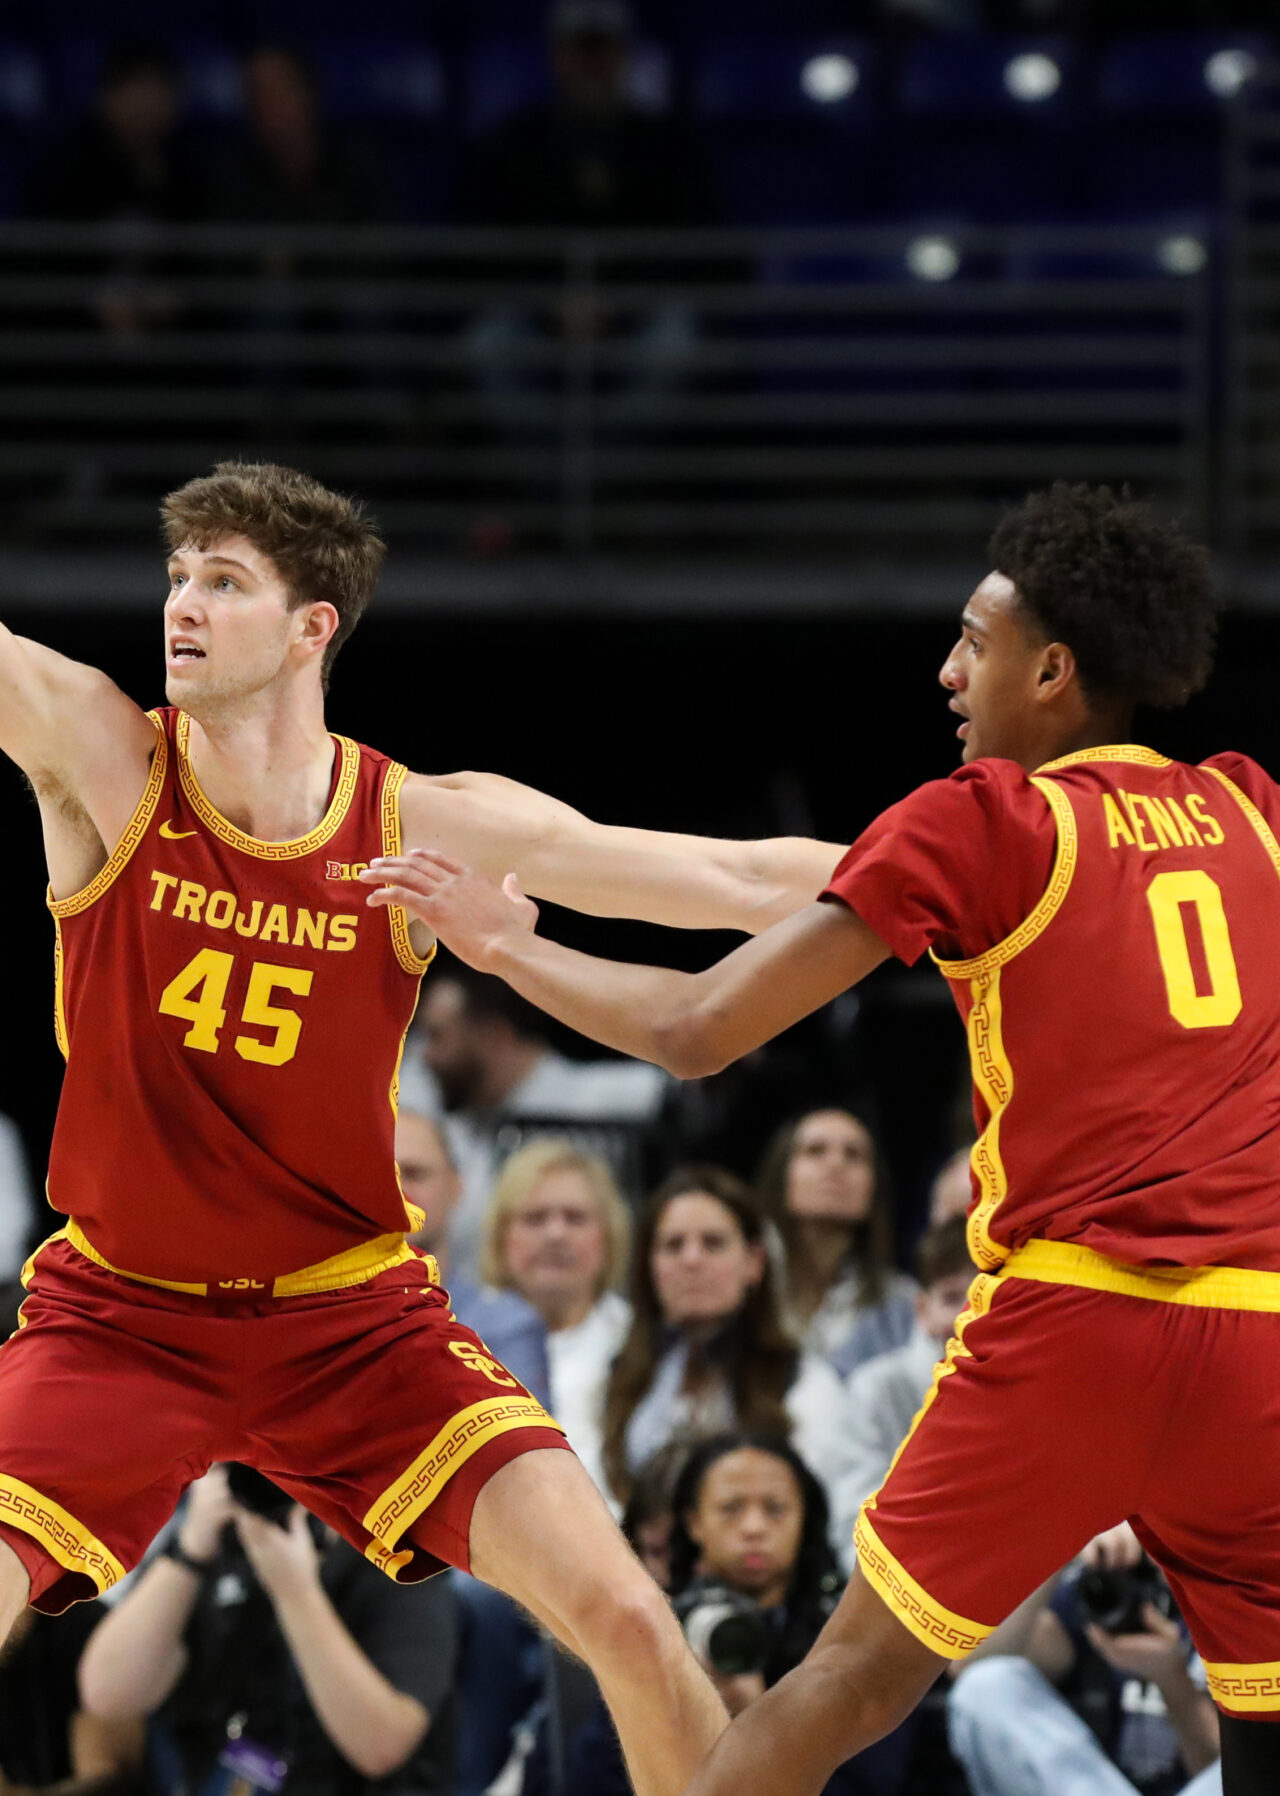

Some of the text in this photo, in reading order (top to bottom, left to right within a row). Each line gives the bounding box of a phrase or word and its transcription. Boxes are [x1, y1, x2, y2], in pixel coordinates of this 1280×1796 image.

[1101, 787, 1226, 852] AENAS
[149, 869, 359, 952] TROJANS
[1145, 869, 1244, 1029] 0
[158, 947, 315, 1067] 45
